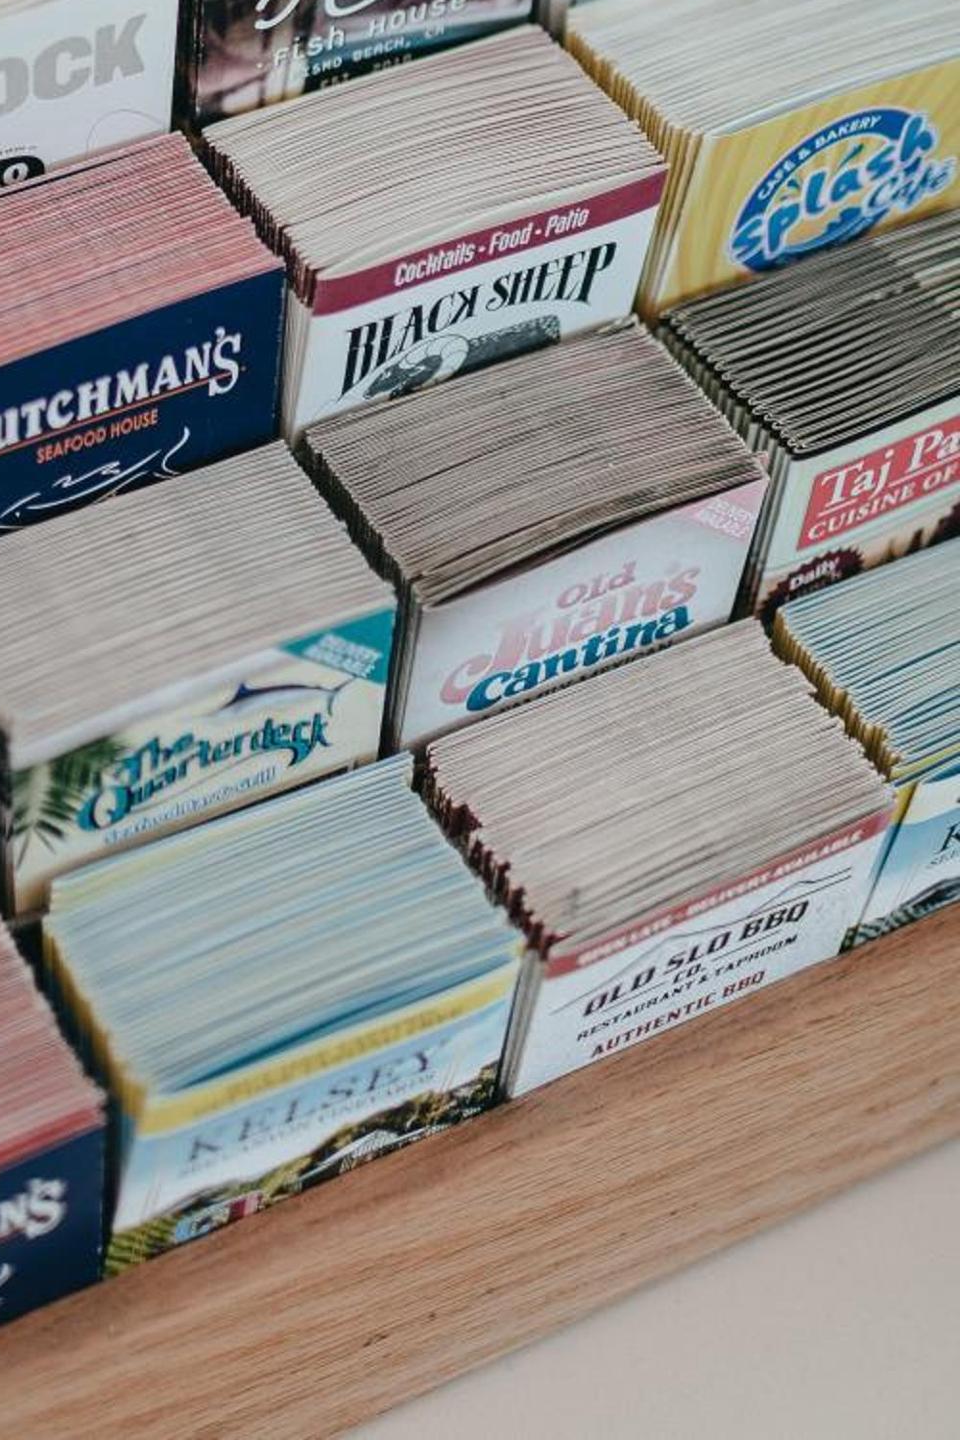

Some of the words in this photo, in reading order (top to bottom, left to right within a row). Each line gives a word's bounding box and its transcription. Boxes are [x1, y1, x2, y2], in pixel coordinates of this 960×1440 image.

[815, 114, 882, 149] BAKERY
[394, 241, 475, 287] Cocktails
[489, 225, 530, 256] Food
[545, 208, 589, 238] Patio
[338, 284, 483, 402] BLACK
[485, 242, 618, 311] SHEEP
[36, 427, 106, 464] SEAFOOD
[111, 408, 159, 438] HOUSE
[822, 449, 893, 507] Taj
[808, 484, 916, 540] CUISINE
[557, 561, 637, 609] Old
[583, 967, 656, 1017] OLD
[663, 931, 733, 976] SLO
[738, 900, 811, 940] BBQ
[577, 979, 696, 1041] RESTAURANT
[592, 994, 717, 1058] AUTHENTIC
[722, 970, 767, 1000] BBQ
